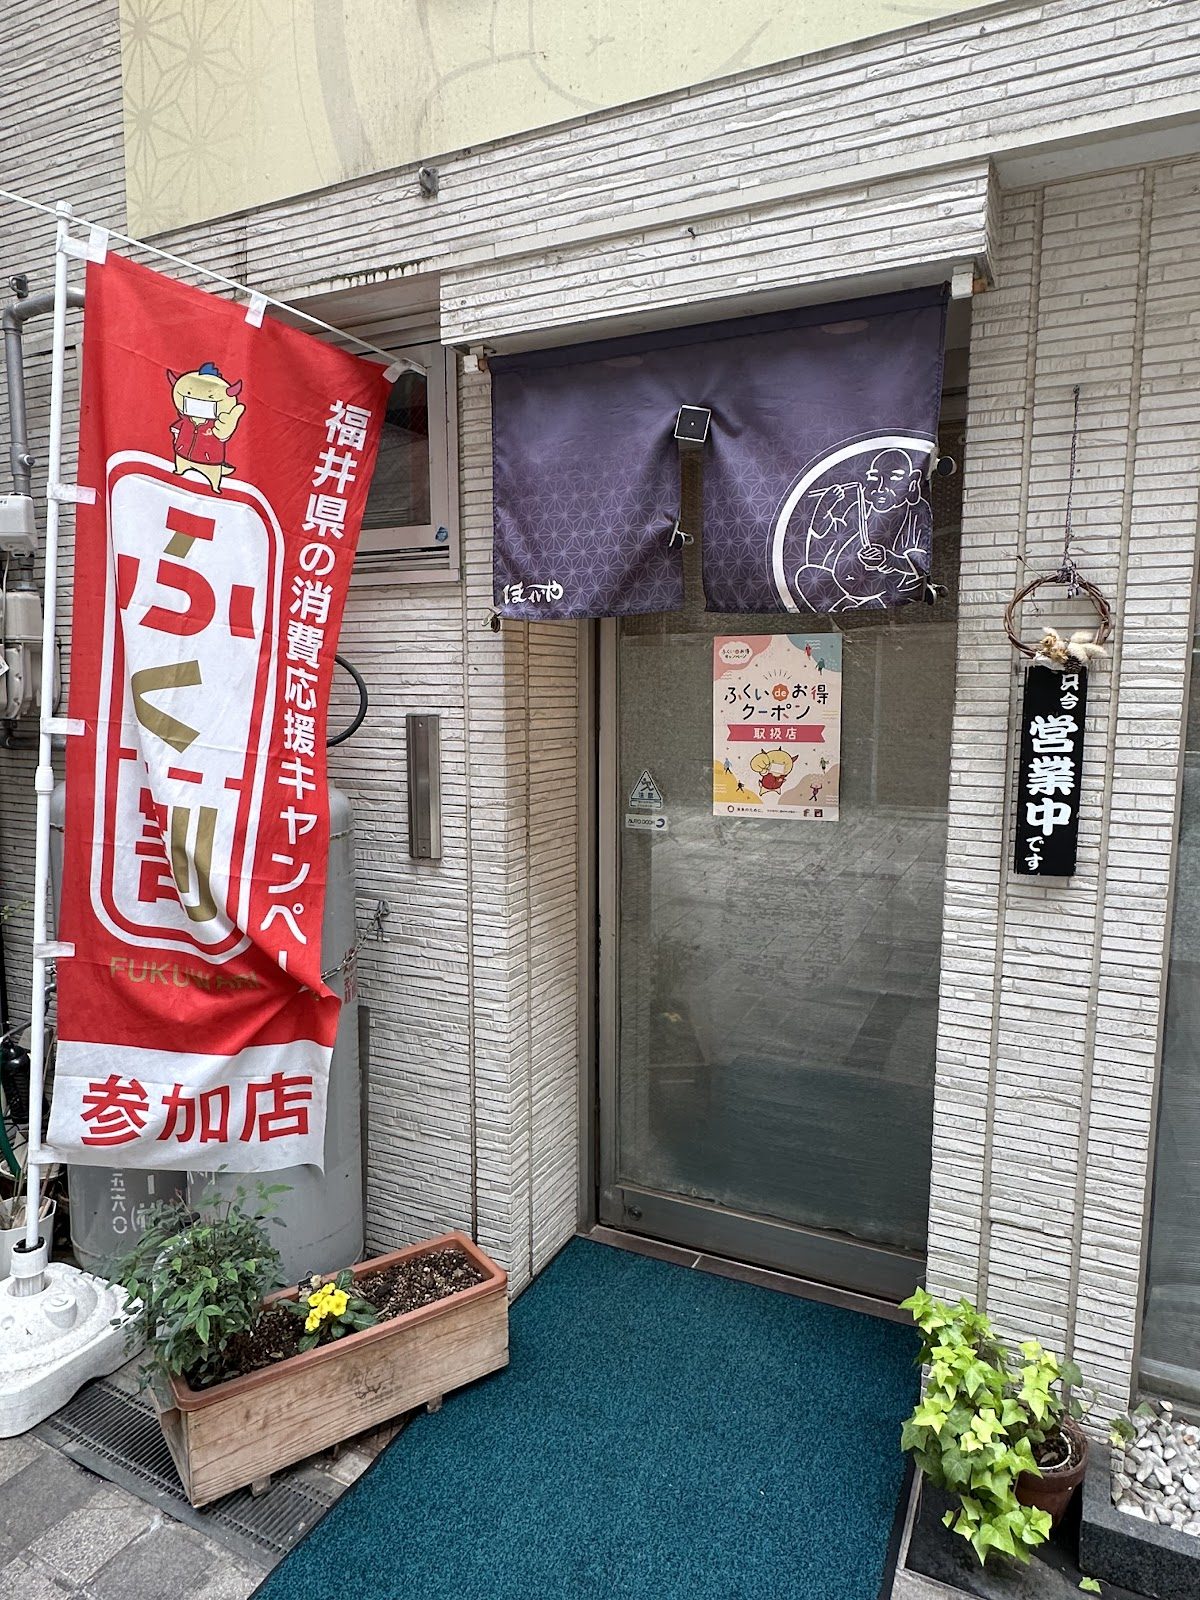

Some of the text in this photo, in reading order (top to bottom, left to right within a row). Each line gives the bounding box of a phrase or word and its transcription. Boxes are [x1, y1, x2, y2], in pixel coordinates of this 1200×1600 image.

[724, 683, 829, 705] ふくいdeお得
[1060, 673, 1080, 710] 只今
[742, 703, 811, 721] クーポン
[753, 727, 798, 740] 取扱店
[1025, 713, 1079, 837] 営業中
[1024, 836, 1045, 871] です
[80, 1072, 313, 1147] 参加店
